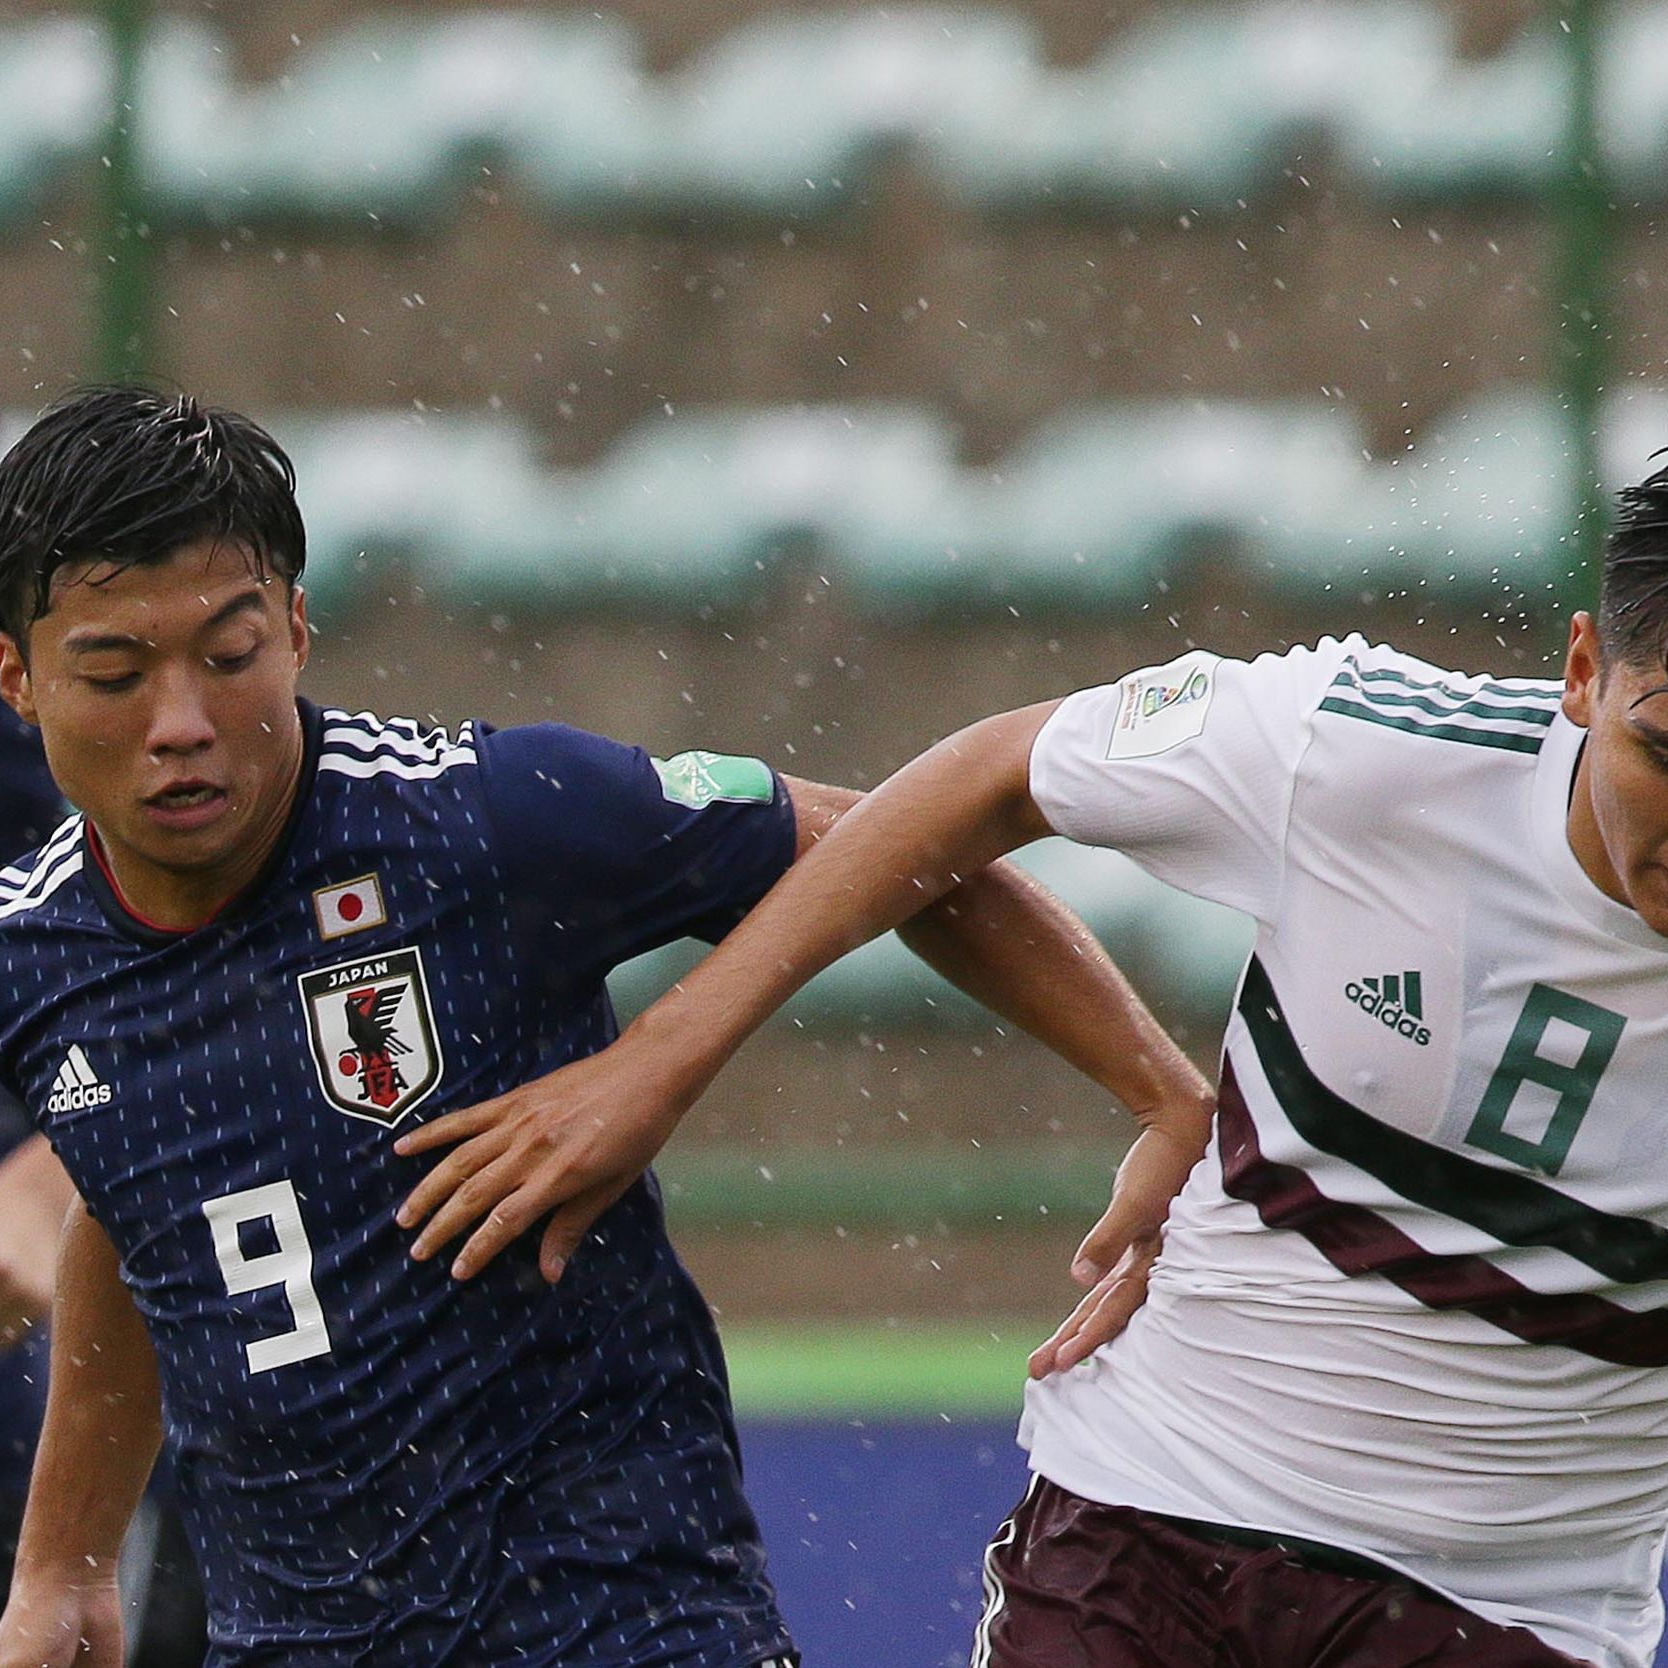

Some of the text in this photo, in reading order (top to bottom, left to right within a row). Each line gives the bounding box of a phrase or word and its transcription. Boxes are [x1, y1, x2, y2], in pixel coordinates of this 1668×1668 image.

[327, 960, 390, 988] JAPAN
[1344, 980, 1433, 1047] adidas
[46, 1083, 113, 1114] adidas
[1462, 981, 1629, 1178] 8
[202, 1180, 333, 1376] 9
